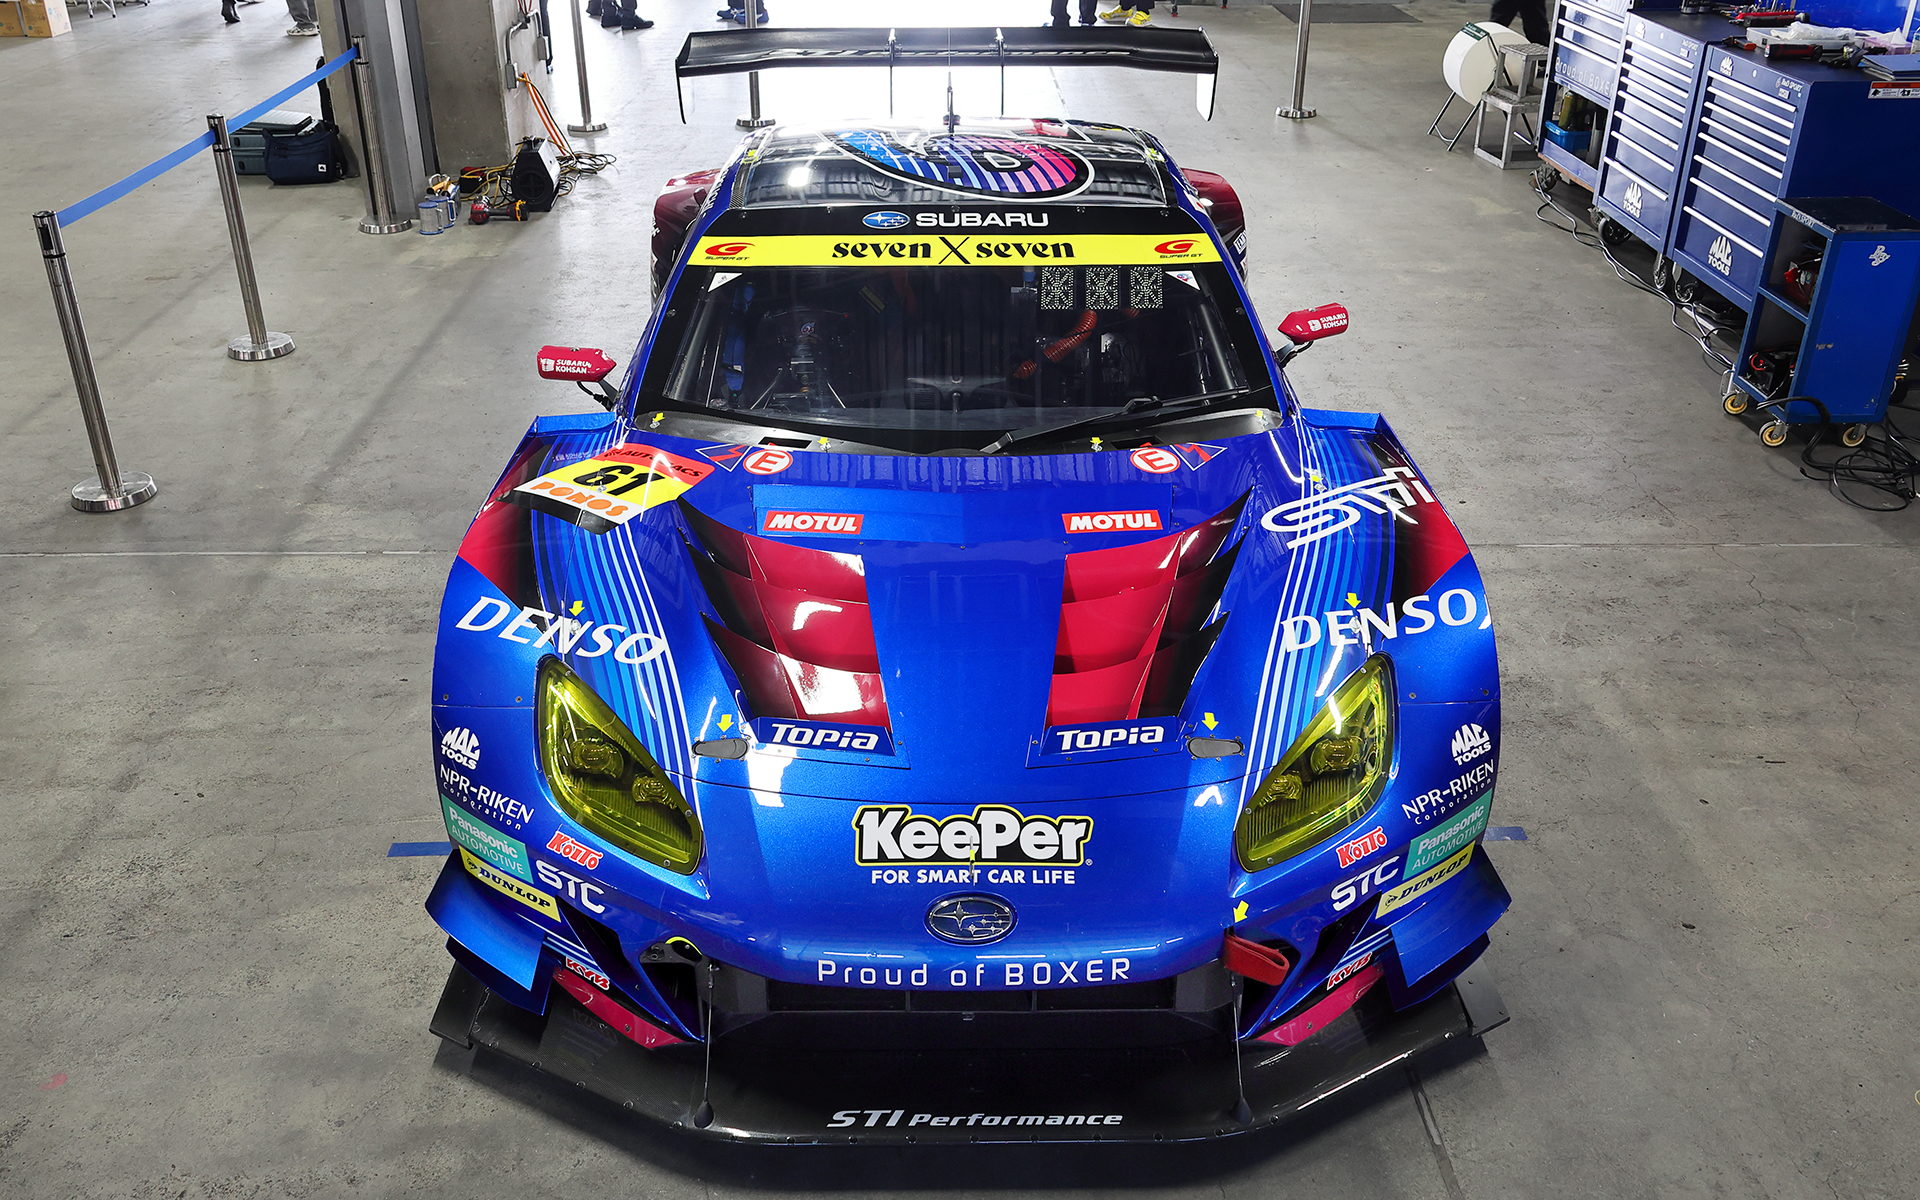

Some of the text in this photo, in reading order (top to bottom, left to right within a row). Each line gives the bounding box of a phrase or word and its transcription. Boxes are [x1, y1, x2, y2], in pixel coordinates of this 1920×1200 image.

[1623, 200, 1640, 219] TOOLS
[1624, 182, 1642, 209] MAC
[916, 212, 1049, 227] SUBARU
[832, 242, 932, 258] seven
[976, 242, 1076, 258] seven
[1708, 254, 1731, 277] TOOLS
[1709, 236, 1732, 267] MAC
[1320, 312, 1346, 324] SUBARU
[1322, 319, 1348, 330] KOHSAN
[555, 366, 587, 374] KOHSAN
[556, 359, 588, 368] SUBARU
[622, 450, 703, 477] AUTACS
[750, 452, 786, 472] E
[1137, 450, 1174, 471] E
[573, 465, 665, 497] 61
[530, 481, 629, 517] PONOS
[767, 513, 858, 532] MOTUL
[1070, 511, 1158, 531] MOTUL
[455, 596, 666, 664] DENSO
[1281, 588, 1477, 653] DENSO
[442, 726, 480, 760] MAC
[1452, 723, 1490, 757] MAC
[1454, 741, 1492, 766] TOOLS
[441, 744, 477, 770] TOOLS
[440, 763, 534, 824] NPR-RIKEN
[1402, 758, 1494, 820] NPR-RIKEN
[1414, 777, 1492, 825] Corporation
[442, 781, 521, 830] Corporation
[449, 805, 518, 859] Panasonic
[857, 808, 1088, 861] KeePer
[1411, 818, 1484, 871] AUTOMOTIVE
[1418, 804, 1484, 855] Panasonic
[452, 825, 525, 875] AUTOMOTIVE
[478, 866, 551, 908] DUNLOP
[535, 859, 605, 914] STC
[871, 869, 1075, 885] FOR SMART CAR LIFE
[1330, 855, 1399, 912] STC
[1398, 852, 1469, 901] DUNLOP
[565, 956, 611, 990] KYB
[818, 957, 1130, 986] Proud of BOXER
[1327, 951, 1373, 990] KYB
[826, 1109, 1123, 1128] STI Performance
